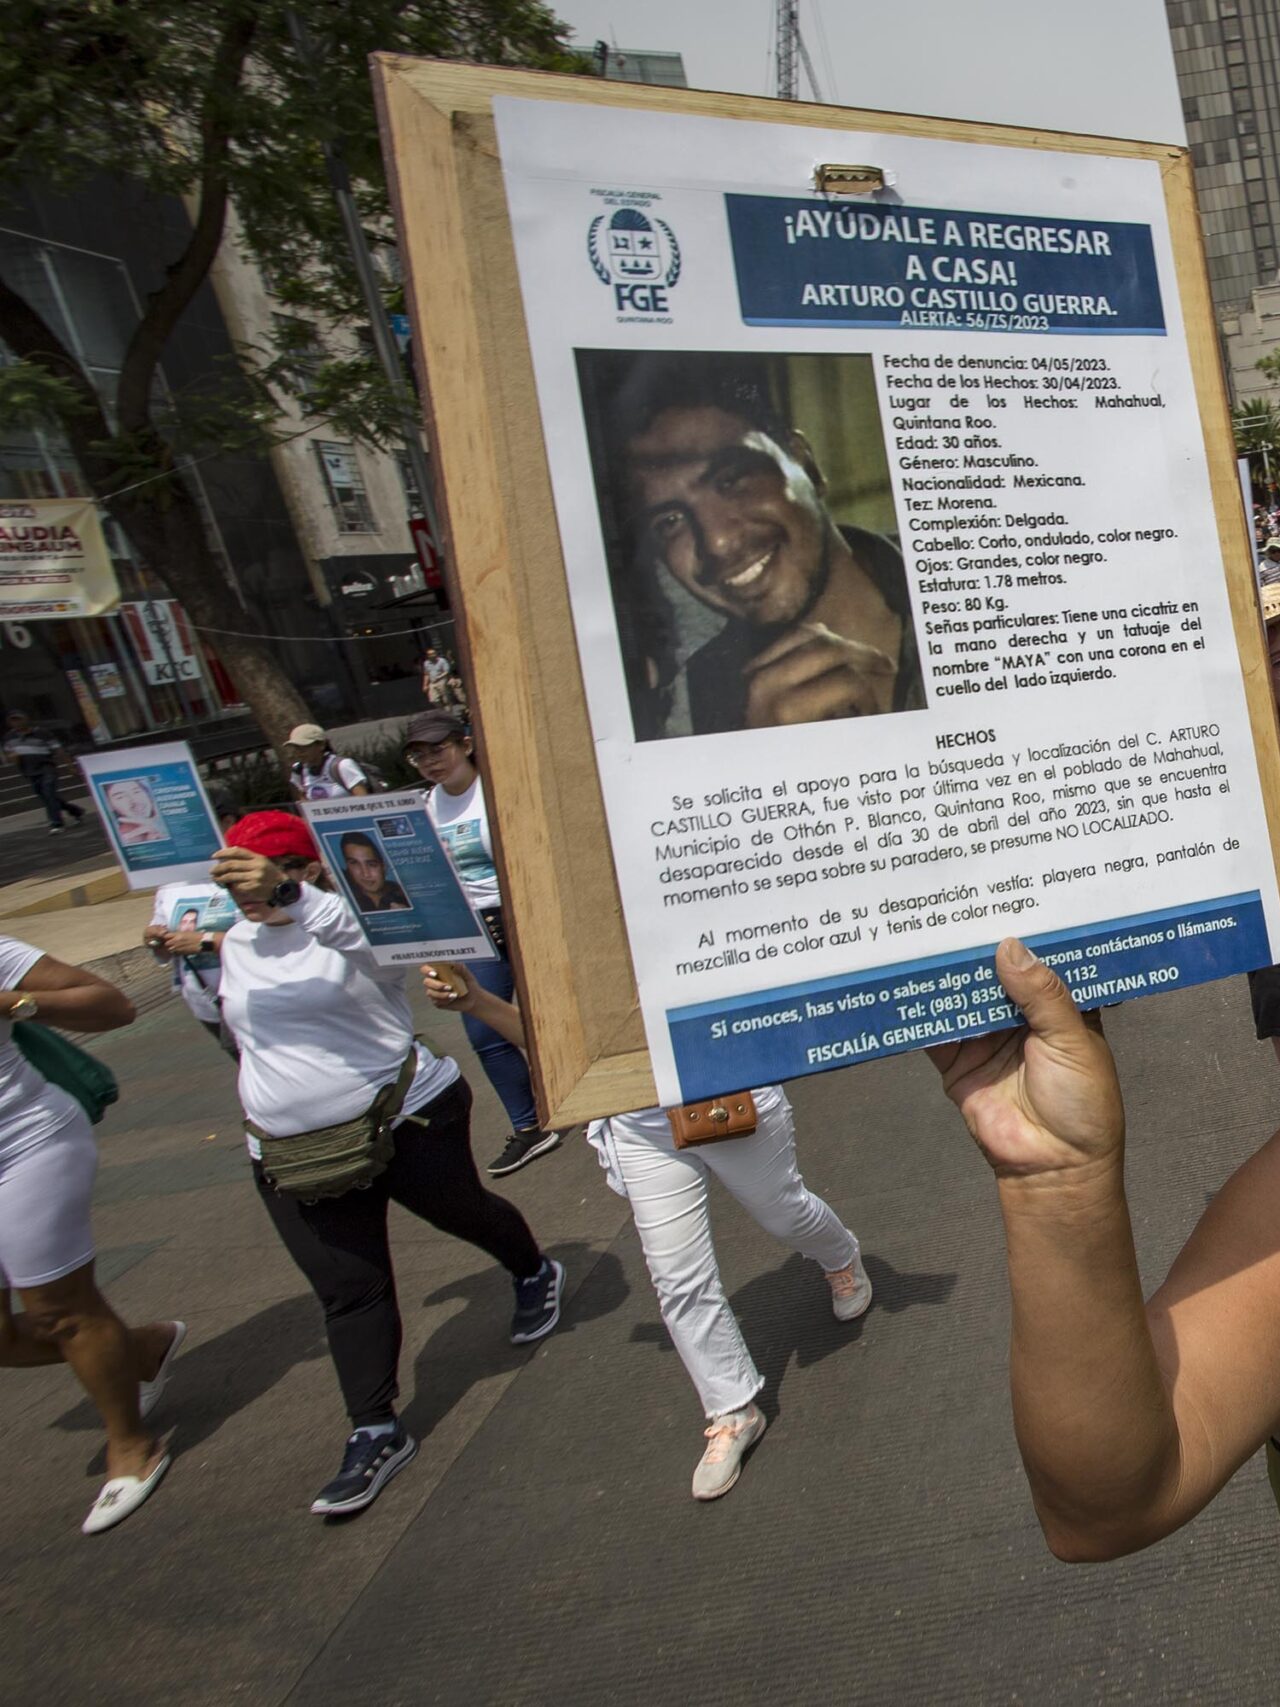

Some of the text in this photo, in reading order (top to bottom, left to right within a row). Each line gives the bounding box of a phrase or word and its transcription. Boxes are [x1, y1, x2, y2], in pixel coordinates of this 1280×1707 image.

[604, 198, 651, 207] DEL ESTADO
[625, 191, 663, 200] GENERAL
[784, 206, 1112, 256] ¡AYÚDALE A REGRESAR
[905, 254, 1018, 287] A CASA!
[614, 283, 669, 312] FGE
[801, 283, 1118, 316] ARTURO CASTILLO GUERRA.
[616, 316, 673, 325] QUINTANA ROO
[900, 309, 1050, 331] ALERTA: 56/ZS/2023
[882, 353, 1111, 373] Fecha de denuncia: 04/05/2023.
[888, 393, 1166, 412] Lugar de los Hechos: Mahahual,
[892, 414, 997, 431] Quintana Roo.
[895, 434, 1003, 450] Edad: 30 años.
[898, 453, 1039, 470] Género: Masculino.
[901, 473, 1086, 492] Nacionalidad: Mexicana.
[903, 496, 998, 512] Tez: Morena.
[908, 511, 1070, 534] Complexión: Delgada.
[911, 528, 1179, 553] Cabello: Corto, ondulado, color negro.
[915, 551, 1108, 576] Ojos: Grandes, color negro.
[918, 571, 1068, 594] Estatura: 1.78 metros.
[921, 595, 1009, 615] Peso: 80 Kg.
[924, 600, 1200, 636] Señas particulares: Tiene una cicatriz en
[935, 664, 1117, 698] cuello del lado izquierdo.
[935, 728, 997, 750] HECHOS
[672, 723, 1221, 812] Se solicita el apoyo para la búsqueda y localización del C. ARTURO
[323, 806, 349, 816] BUSCO
[349, 804, 366, 813] POR
[698, 836, 1240, 949] Al momento de su desaparición vestía: playera negra, pantalón de
[1037, 916, 1238, 967] ersona contáctanos o llámanos.
[1064, 964, 1099, 984] 1132
[1071, 966, 1180, 1004] QUINTANA ROO
[710, 965, 993, 1039] Si conoces, has visto o sabes algo de
[896, 1001, 927, 1021] Tel:
[929, 992, 969, 1018] (983)
[807, 1031, 881, 1065] FISCALÍA
[882, 1017, 956, 1047] GENERAL
[955, 1010, 987, 1030] DEL
